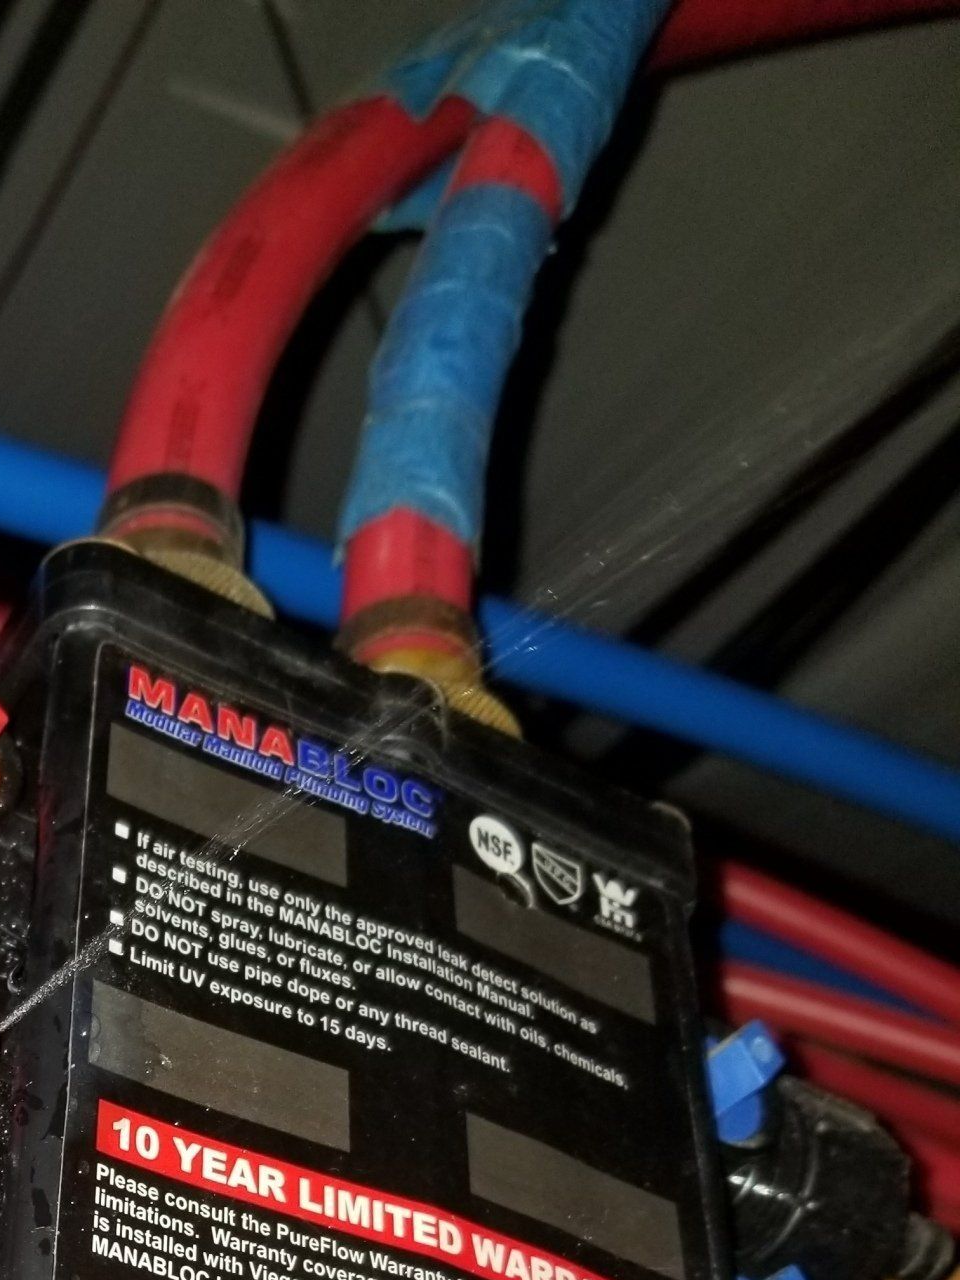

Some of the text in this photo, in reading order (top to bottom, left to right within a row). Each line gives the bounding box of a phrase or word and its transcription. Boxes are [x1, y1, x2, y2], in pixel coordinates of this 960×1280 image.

[126, 699, 202, 746] Modular
[284, 767, 370, 814] Plumbing
[129, 664, 434, 818] MANABLOC
[477, 828, 512, 861] NSF
[134, 898, 357, 990] solvents, glues, or fluxes.
[136, 853, 535, 1020] described in the MANABLOC Installation Manual.
[136, 876, 629, 1090] DO NOT spray, lubricate, or allow contact with oils, chemicals,
[137, 831, 598, 1035] If air testing, use only the approved leak detect solution as
[130, 946, 392, 1051] Limit UV exposure to 15 days.
[131, 918, 511, 1073] DO NOT use pipe dope or any thread sealant.
[93, 1211, 110, 1231] is
[116, 1218, 198, 1263] installed
[203, 1249, 243, 1276] with
[95, 1187, 200, 1239] limitations.
[211, 1226, 297, 1271] Warranty
[96, 1164, 159, 1201] Please
[165, 1191, 235, 1227] consult
[242, 1213, 270, 1237] the
[277, 1222, 365, 1265] PureFlow
[113, 1117, 159, 1160] 10
[173, 1136, 286, 1203] YEAR
[299, 1177, 462, 1255] LIMITED
